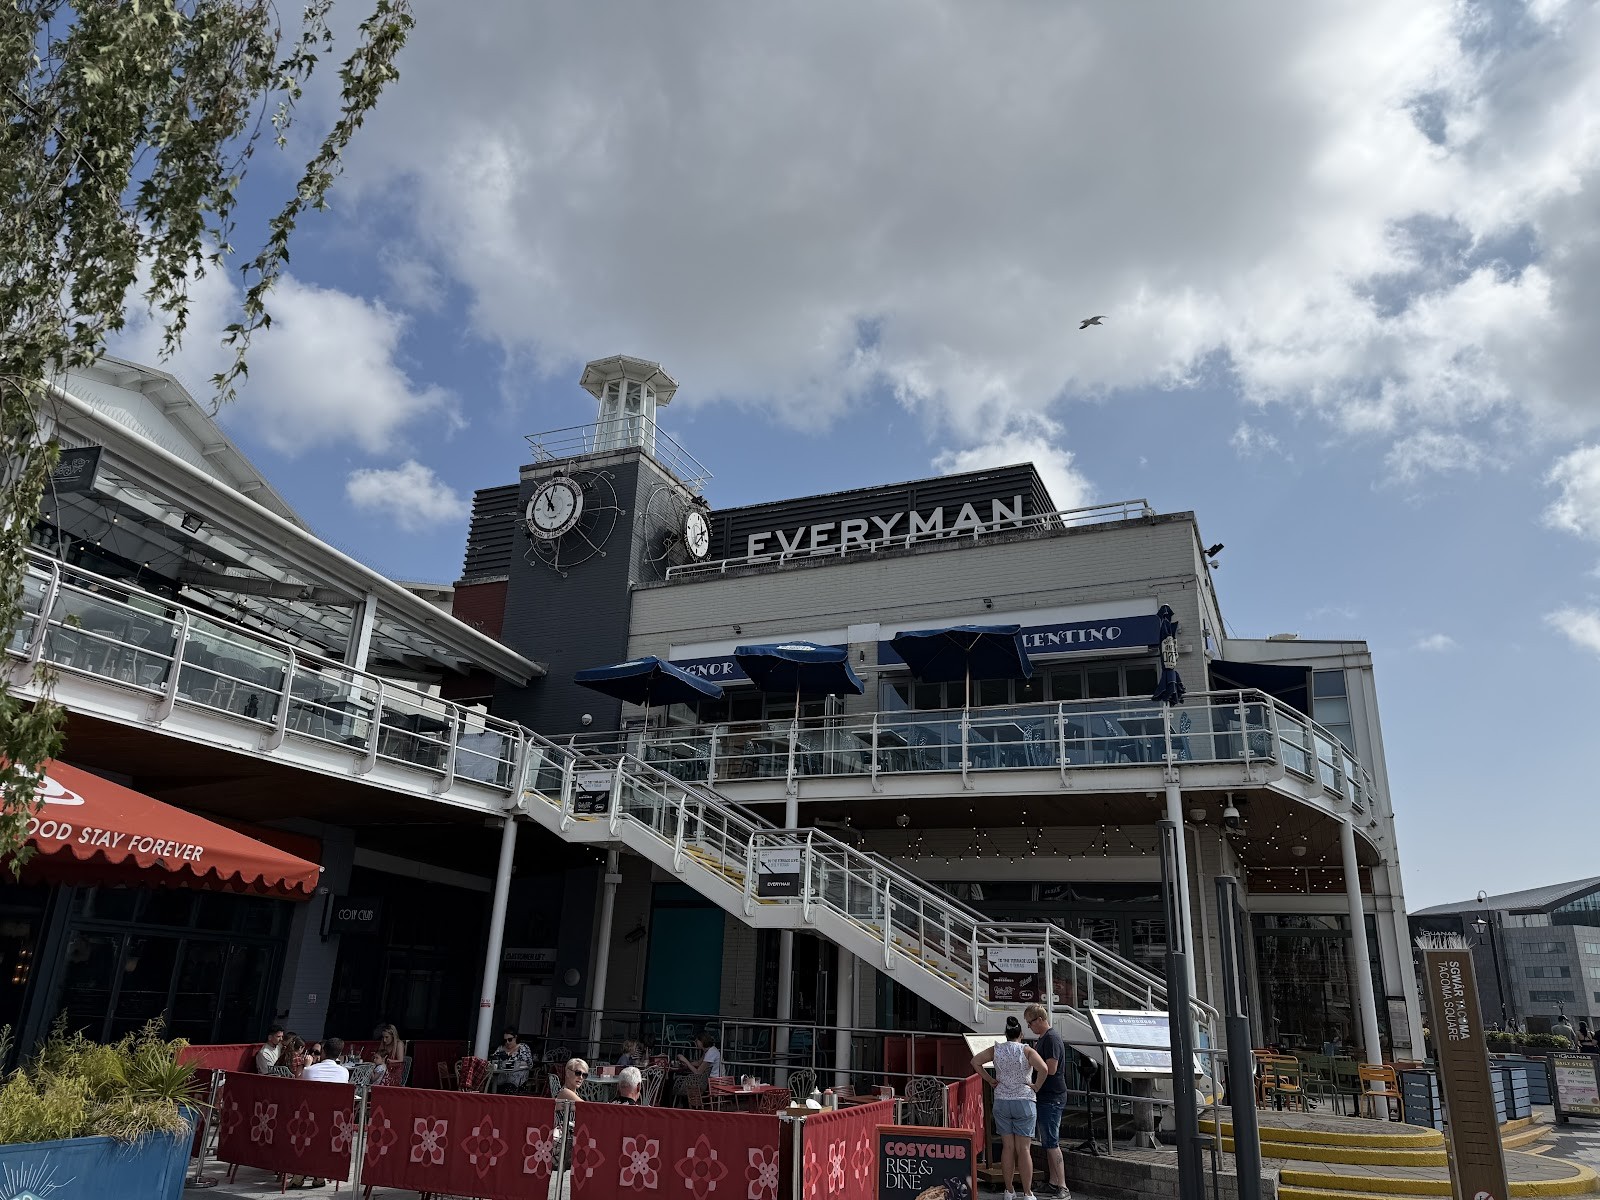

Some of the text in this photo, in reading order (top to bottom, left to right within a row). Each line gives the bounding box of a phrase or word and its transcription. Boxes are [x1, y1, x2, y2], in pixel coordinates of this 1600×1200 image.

[748, 495, 1023, 563] EVERYMAN
[17, 817, 203, 861] OOD STAY FOREVER
[1438, 961, 1459, 1041] TACOMA SQUARE
[1450, 960, 1471, 1040] SGWÂR TACOMA
[885, 1142, 966, 1160] COSYCLUB
[886, 1158, 933, 1175] RISE &
[886, 1173, 922, 1190] DINE
